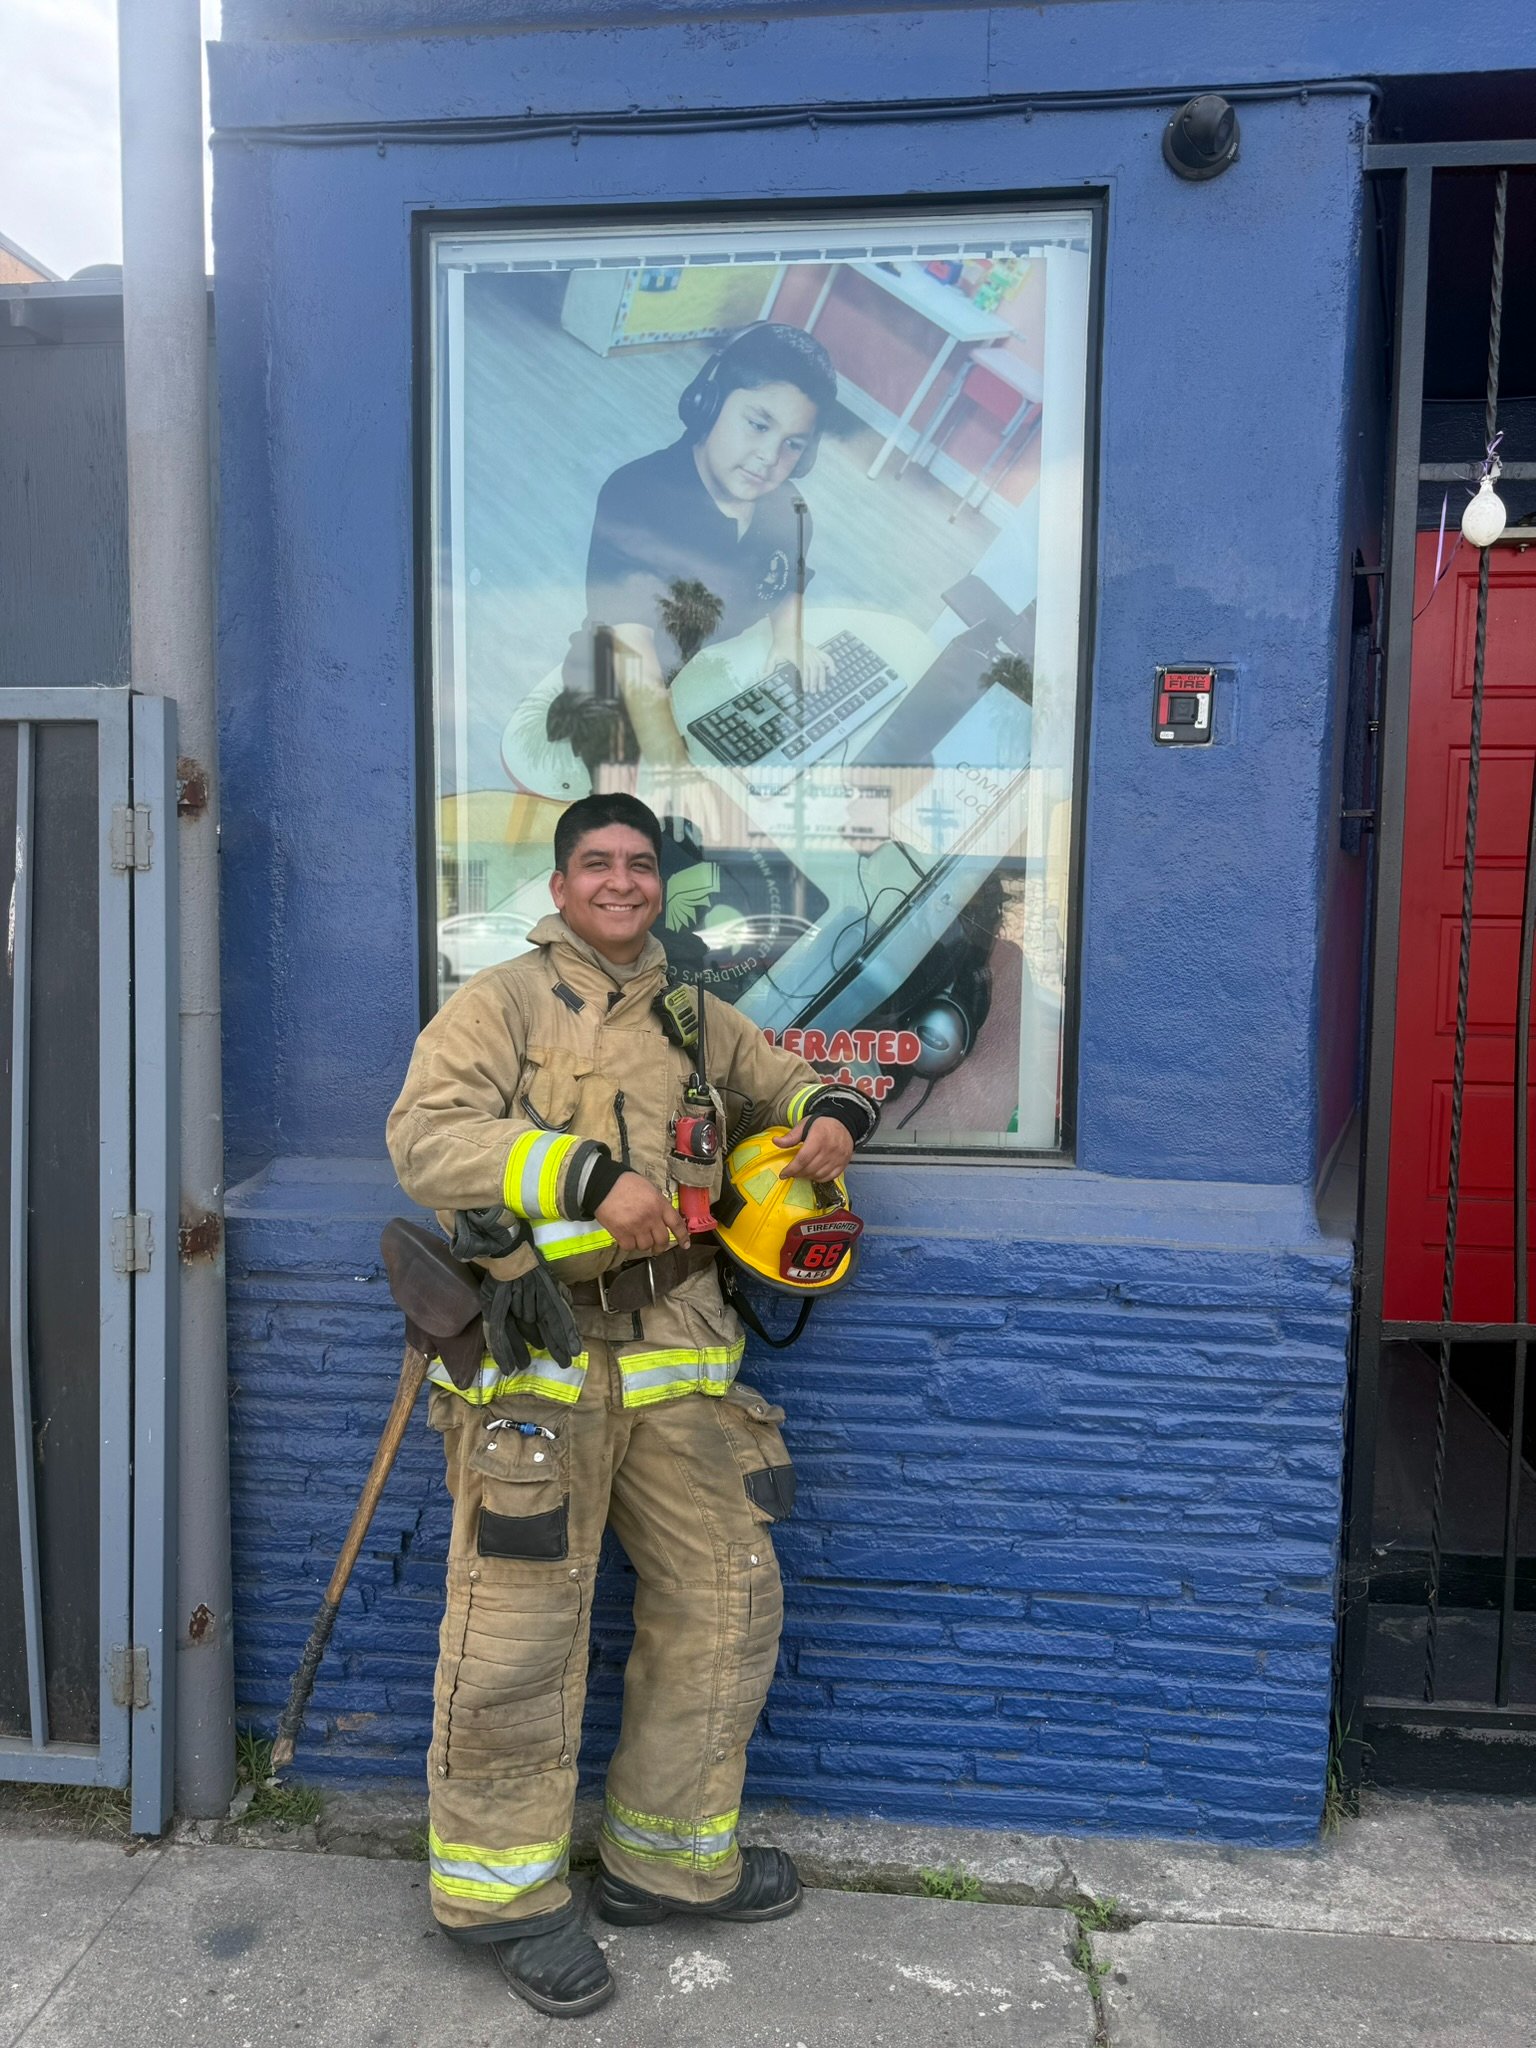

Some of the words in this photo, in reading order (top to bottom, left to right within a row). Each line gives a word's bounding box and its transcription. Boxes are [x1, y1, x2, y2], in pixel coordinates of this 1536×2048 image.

[1169, 680, 1206, 688] FIRE
[682, 956, 757, 983] CHILDREN'S
[807, 1222, 857, 1233] FIREFIGHTER
[803, 1243, 844, 1268] 66
[796, 1270, 827, 1278] LAFD
